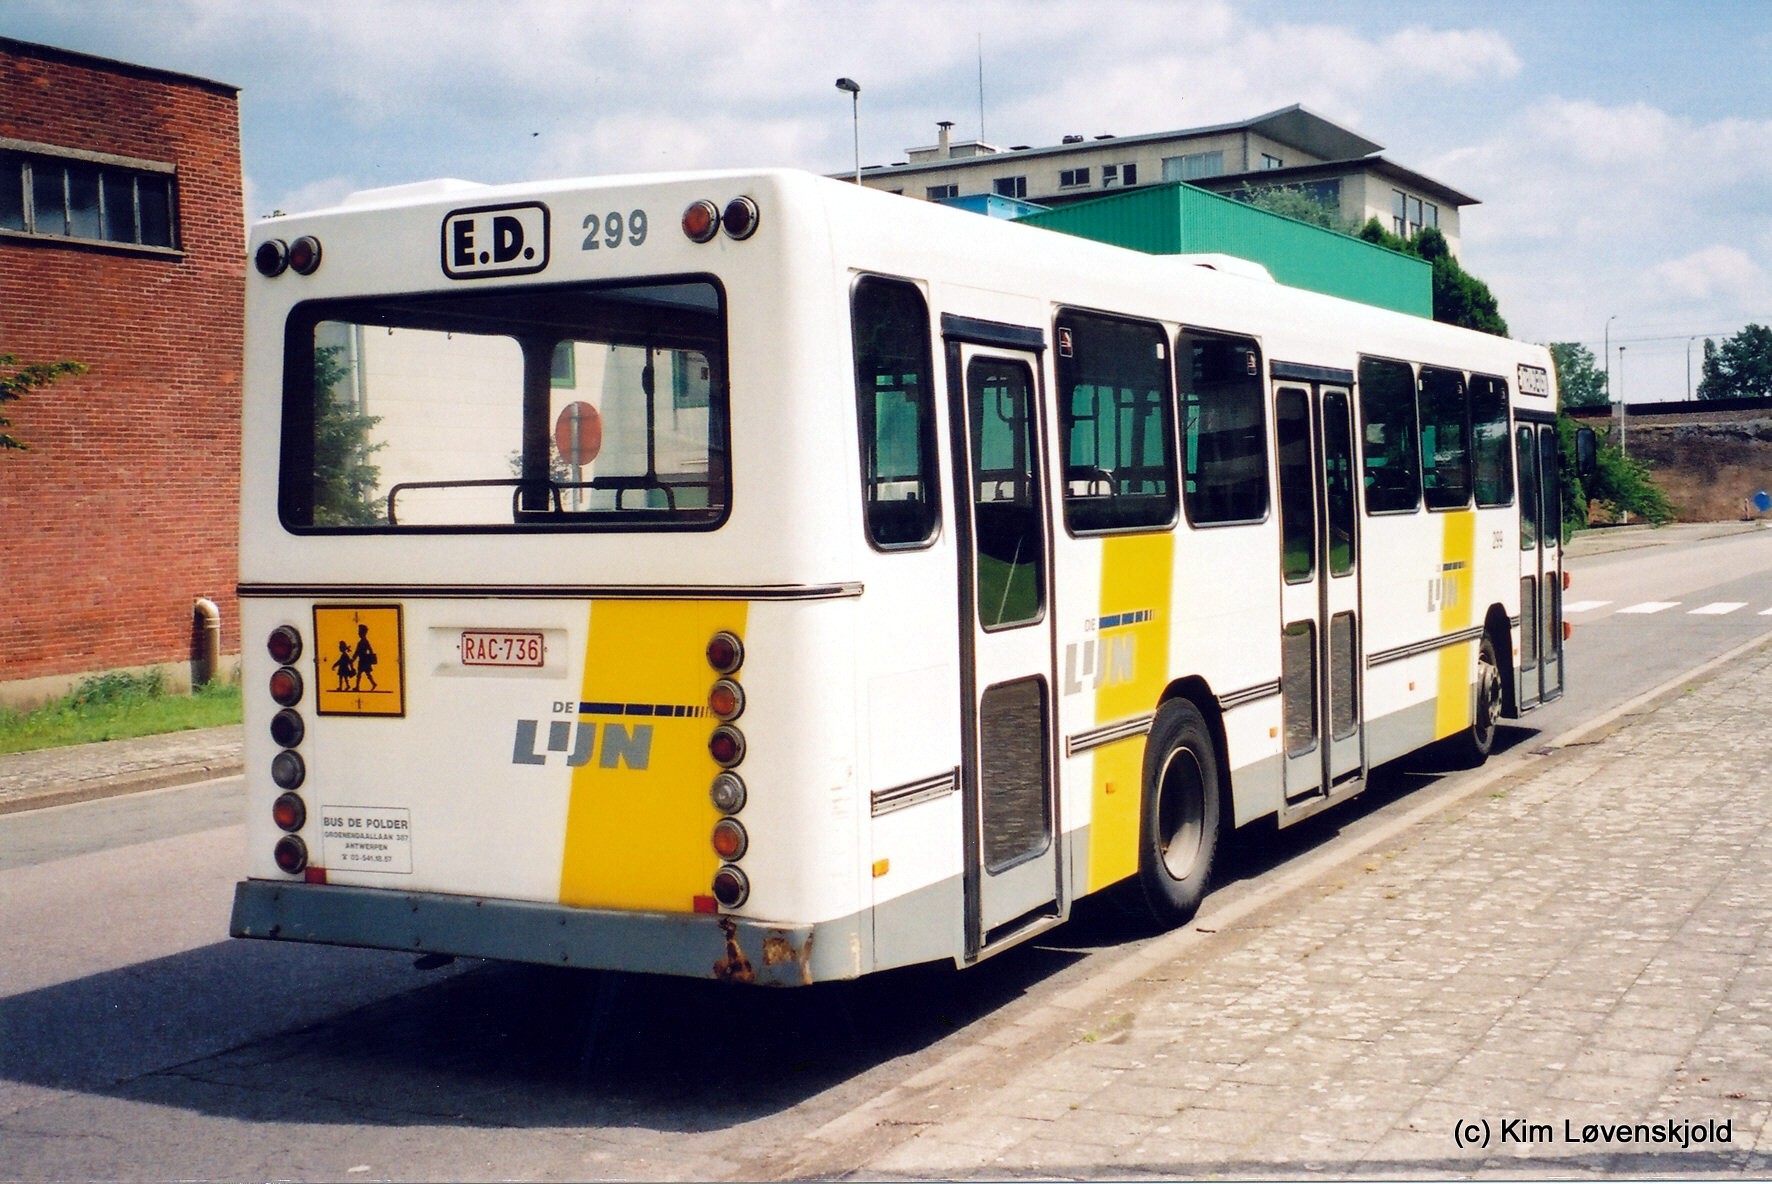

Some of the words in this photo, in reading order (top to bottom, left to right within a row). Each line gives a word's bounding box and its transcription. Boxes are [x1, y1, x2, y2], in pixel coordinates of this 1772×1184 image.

[454, 216, 534, 266] E.D.
[582, 209, 648, 250] 299
[1084, 618, 1096, 632] DE
[465, 638, 539, 660] RAC-736
[1064, 633, 1137, 696] LIJN
[552, 701, 574, 713] DE
[512, 719, 654, 770] LIJN
[323, 817, 344, 827] BUS
[348, 818, 362, 828] DE
[366, 819, 408, 829] POLDER
